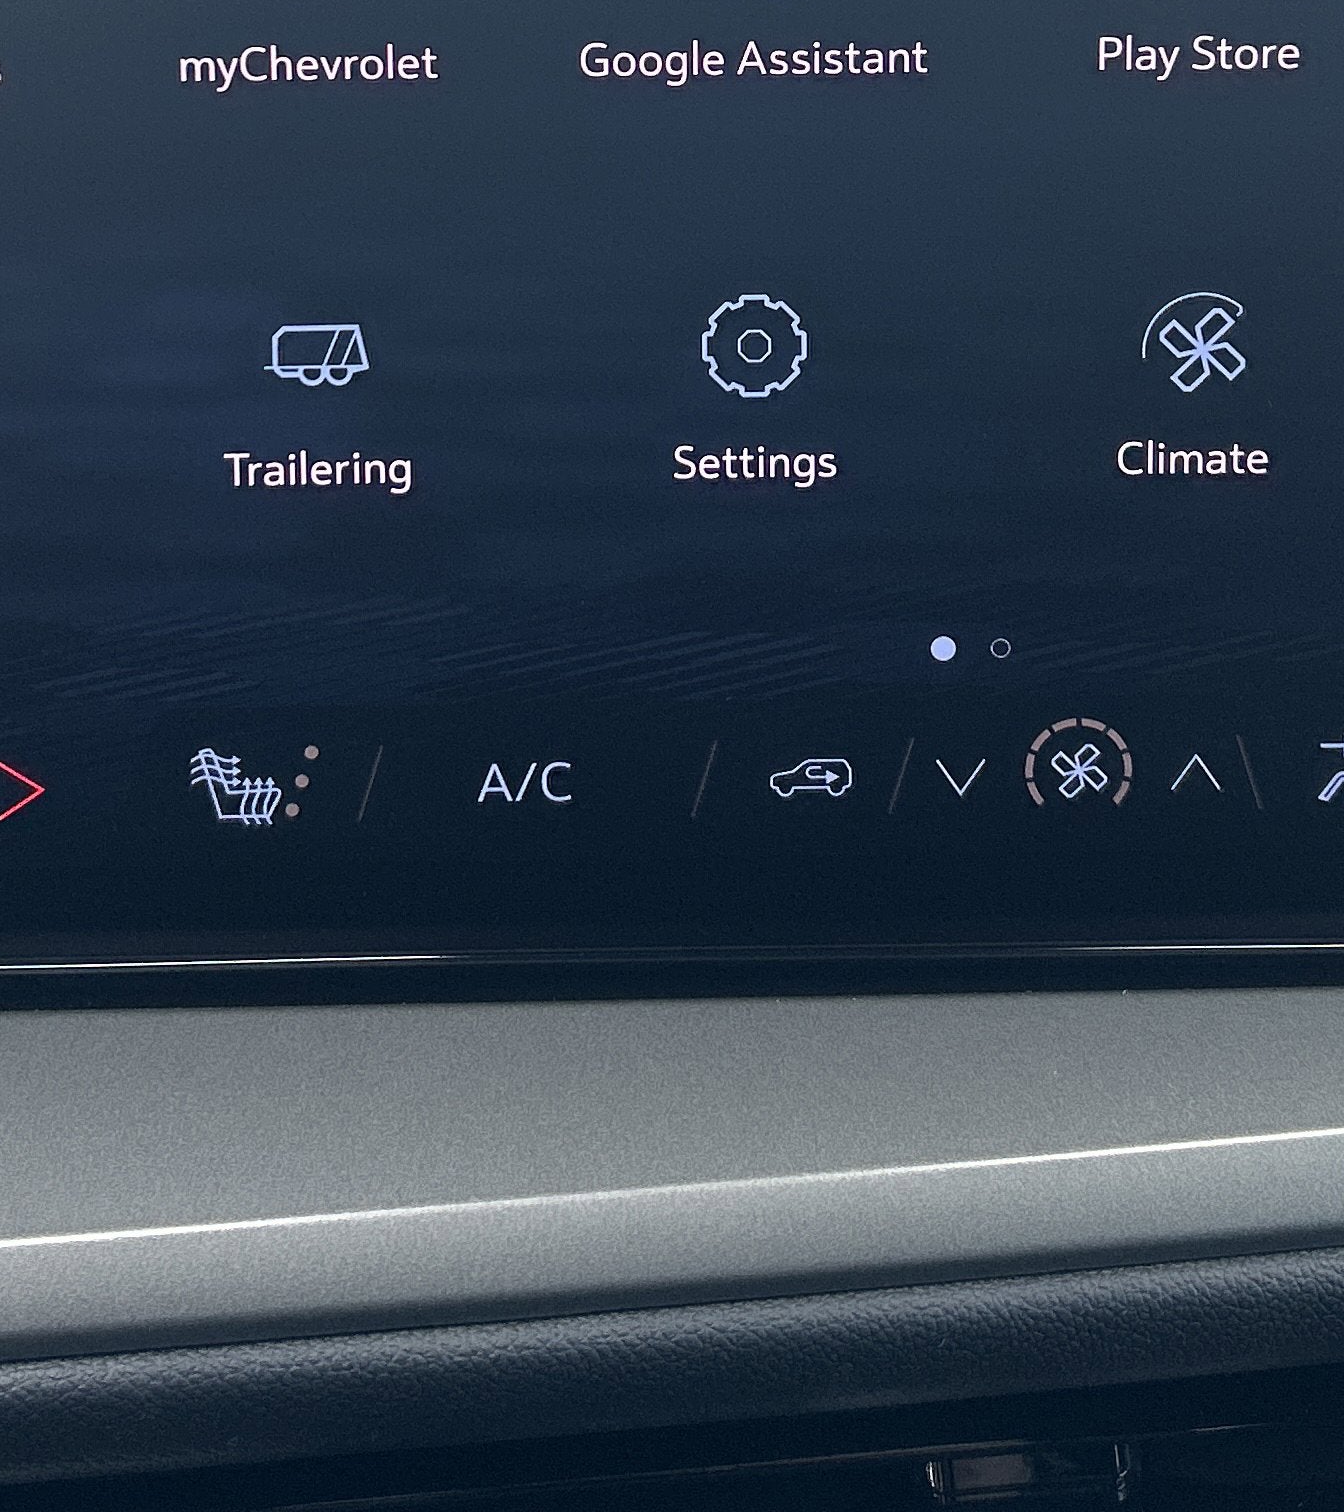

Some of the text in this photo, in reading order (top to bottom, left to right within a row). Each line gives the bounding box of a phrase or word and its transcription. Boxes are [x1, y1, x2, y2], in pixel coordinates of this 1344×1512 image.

[179, 43, 439, 93] myChevrolet
[580, 39, 928, 87] Google Assistant
[1098, 34, 1300, 81] Play Store
[223, 449, 412, 495] Trailering
[673, 445, 837, 488] Settings
[1117, 439, 1269, 476] Climate
[477, 761, 572, 803] A/C
